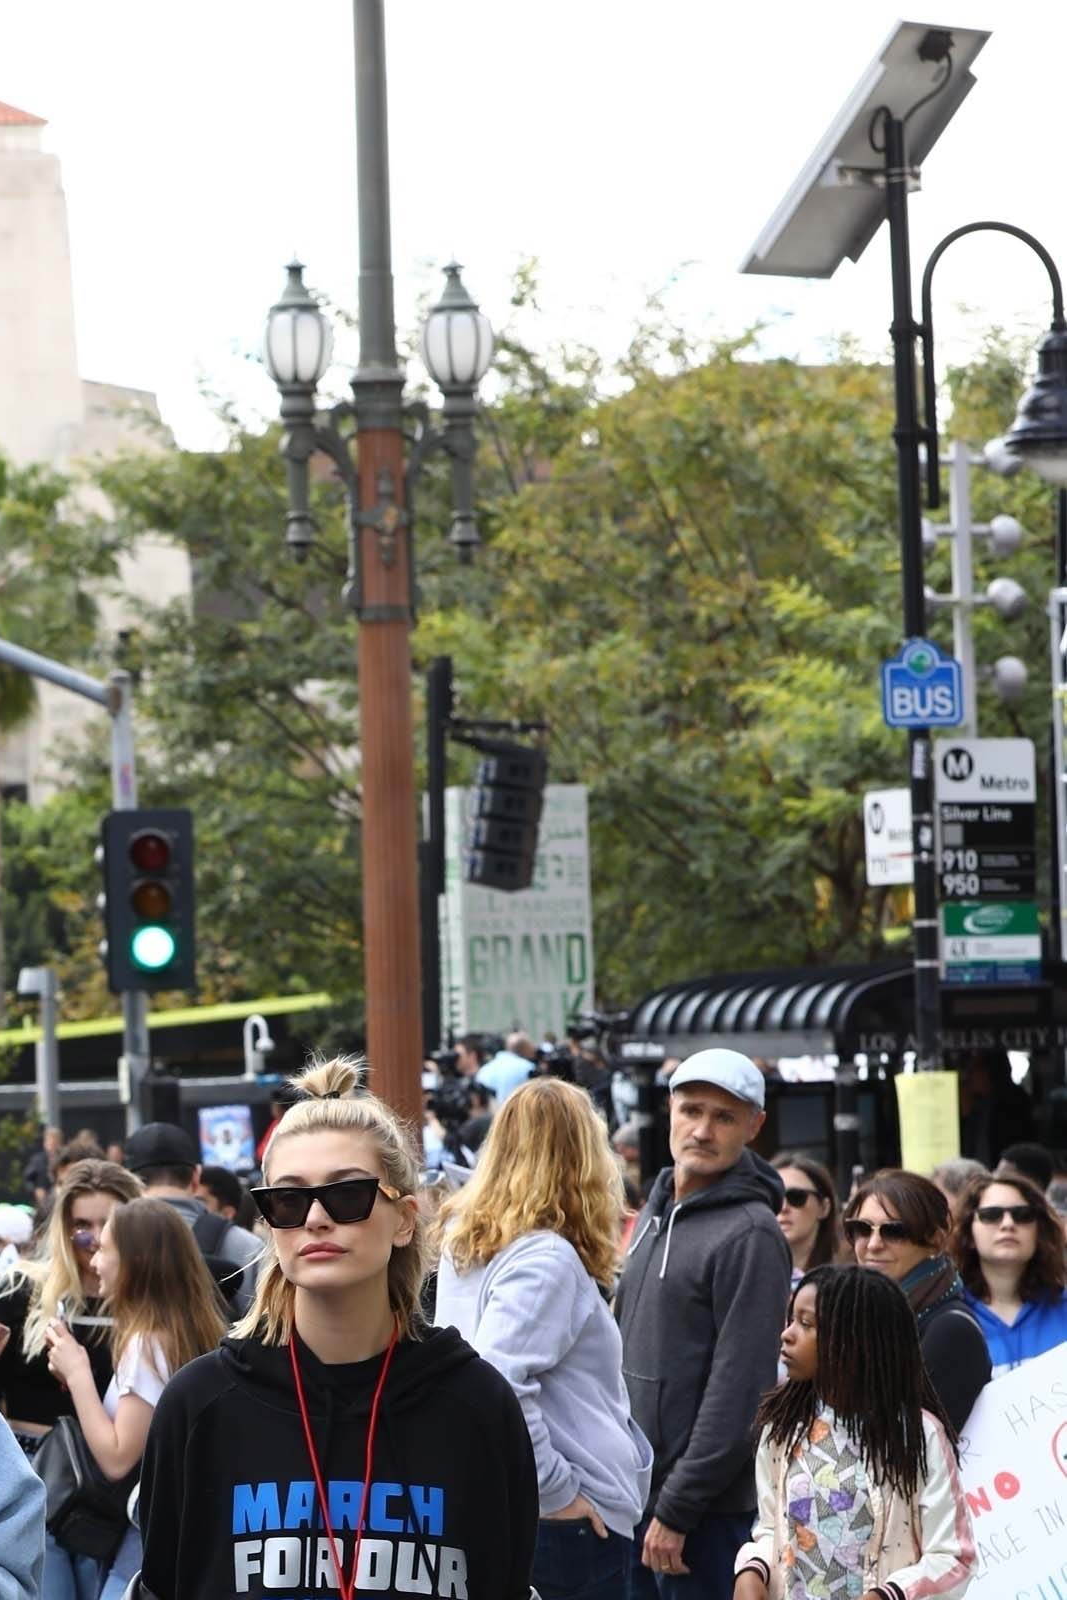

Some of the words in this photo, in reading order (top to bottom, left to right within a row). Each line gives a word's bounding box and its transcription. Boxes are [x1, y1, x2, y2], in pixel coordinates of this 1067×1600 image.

[893, 685, 953, 717] BUS
[980, 775, 1029, 790] Metro
[942, 805, 979, 821] Silver
[983, 805, 1012, 822] Line
[942, 850, 977, 871] 910
[943, 874, 979, 895] 950
[470, 932, 586, 987] GRAND
[232, 1480, 444, 1536] MARCH
[965, 1471, 1021, 1518] NO
[1034, 1499, 1065, 1536] IN
[234, 1537, 345, 1592] FOR
[353, 1538, 469, 1600] OUR
